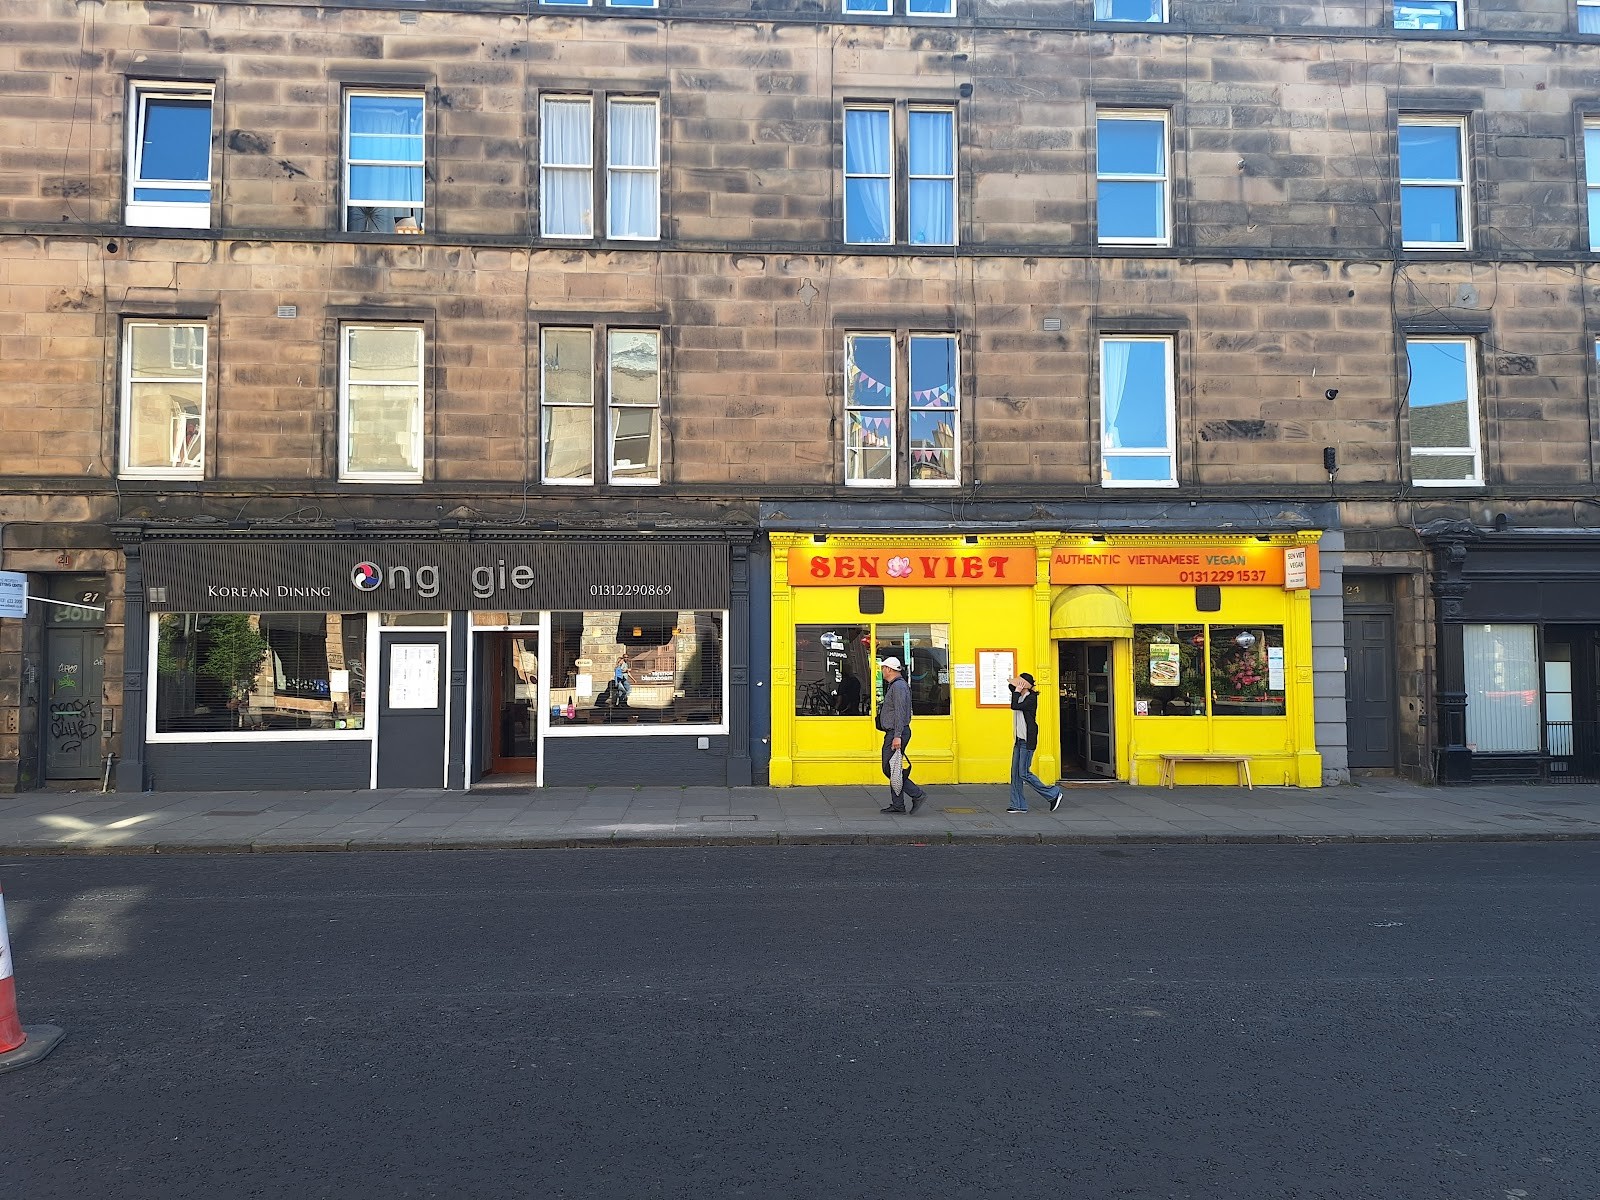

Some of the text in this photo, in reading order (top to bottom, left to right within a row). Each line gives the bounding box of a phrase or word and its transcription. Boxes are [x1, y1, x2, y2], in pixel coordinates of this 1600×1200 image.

[1055, 554, 1246, 566] AUTHENTIC VIETNAMESE VEGAN
[810, 556, 1009, 578] SEN VIET
[471, 559, 535, 599] gie
[208, 585, 331, 597] KOREAN DINING
[590, 584, 672, 596] 01312290869
[82, 592, 99, 602] 21
